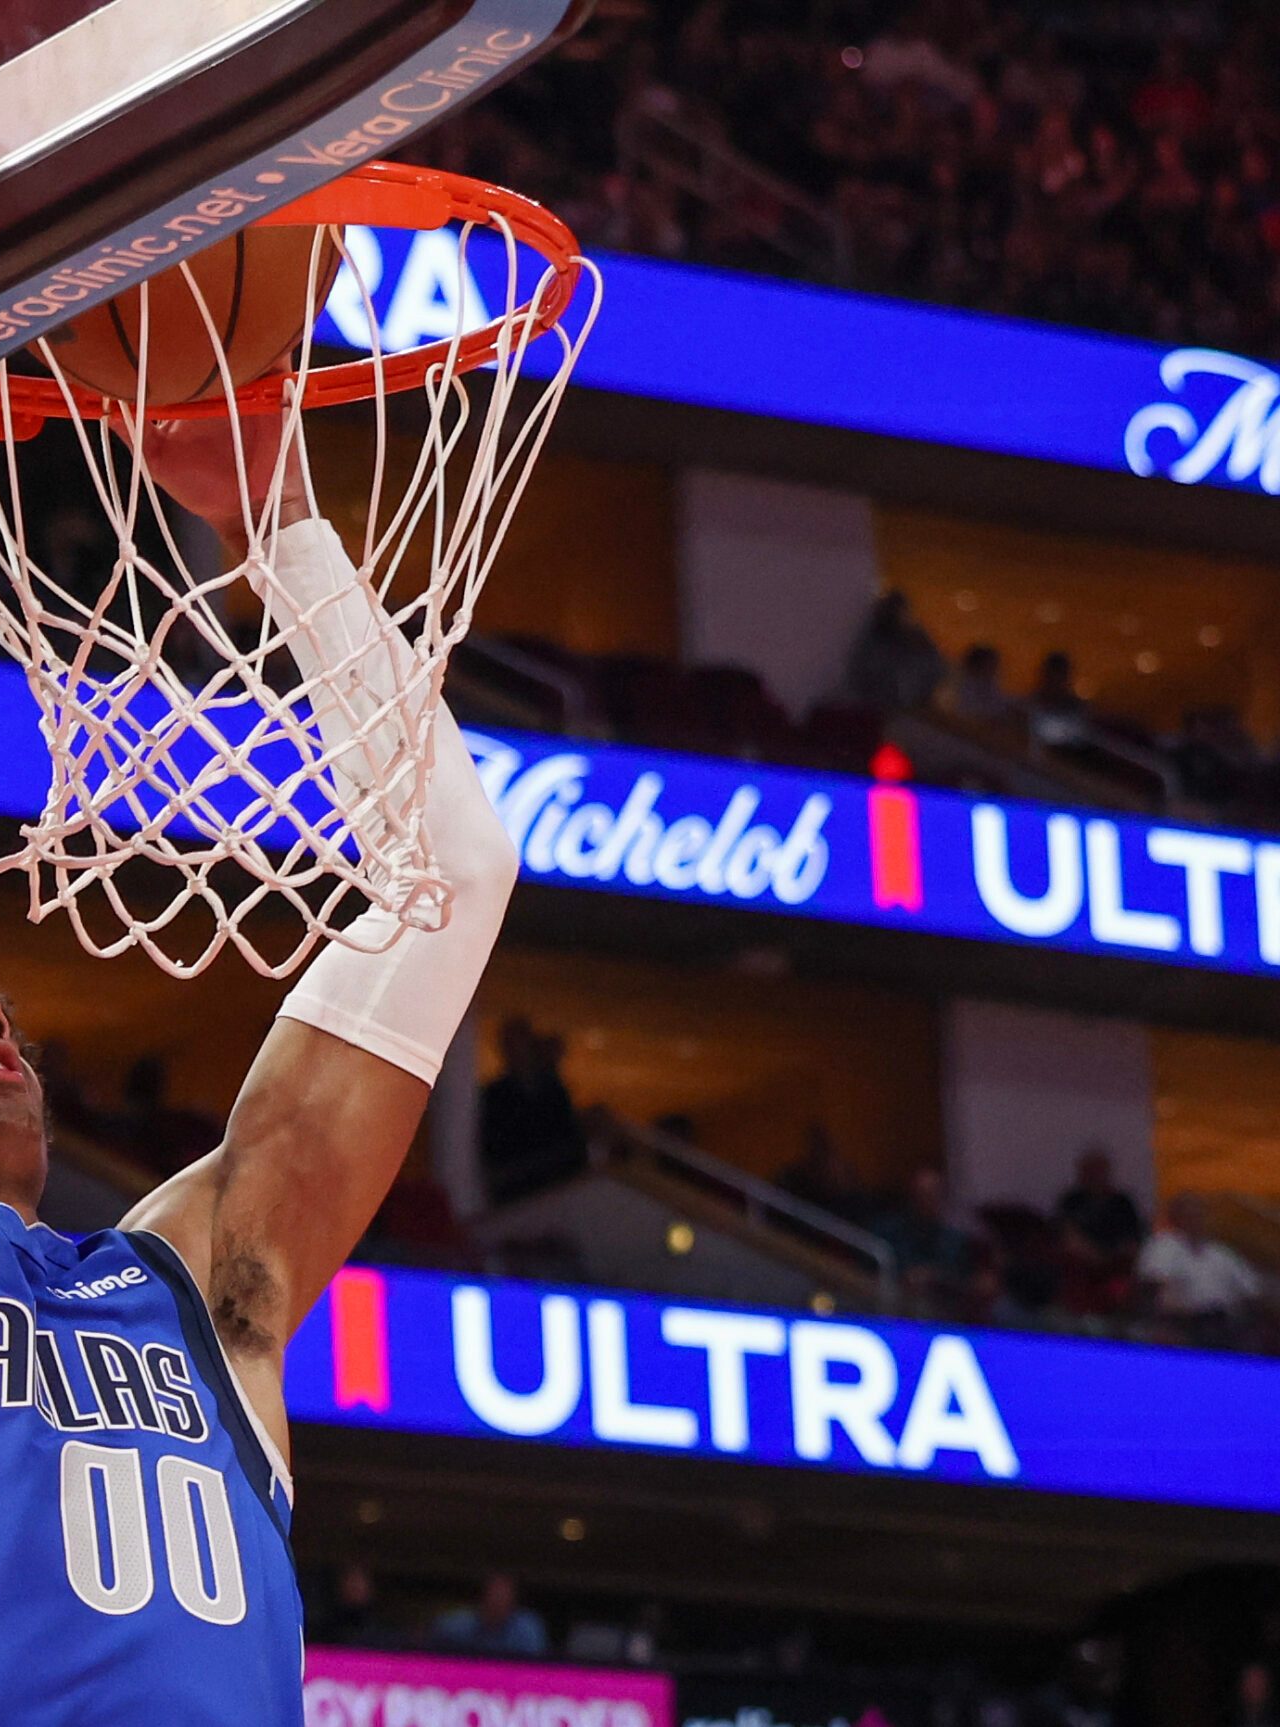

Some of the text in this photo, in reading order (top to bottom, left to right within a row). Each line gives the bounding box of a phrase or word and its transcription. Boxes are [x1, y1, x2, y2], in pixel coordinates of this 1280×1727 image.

[971, 803, 1280, 966] ULT
[451, 1285, 1020, 1479] ULTRA
[60, 1440, 247, 1626] 00
